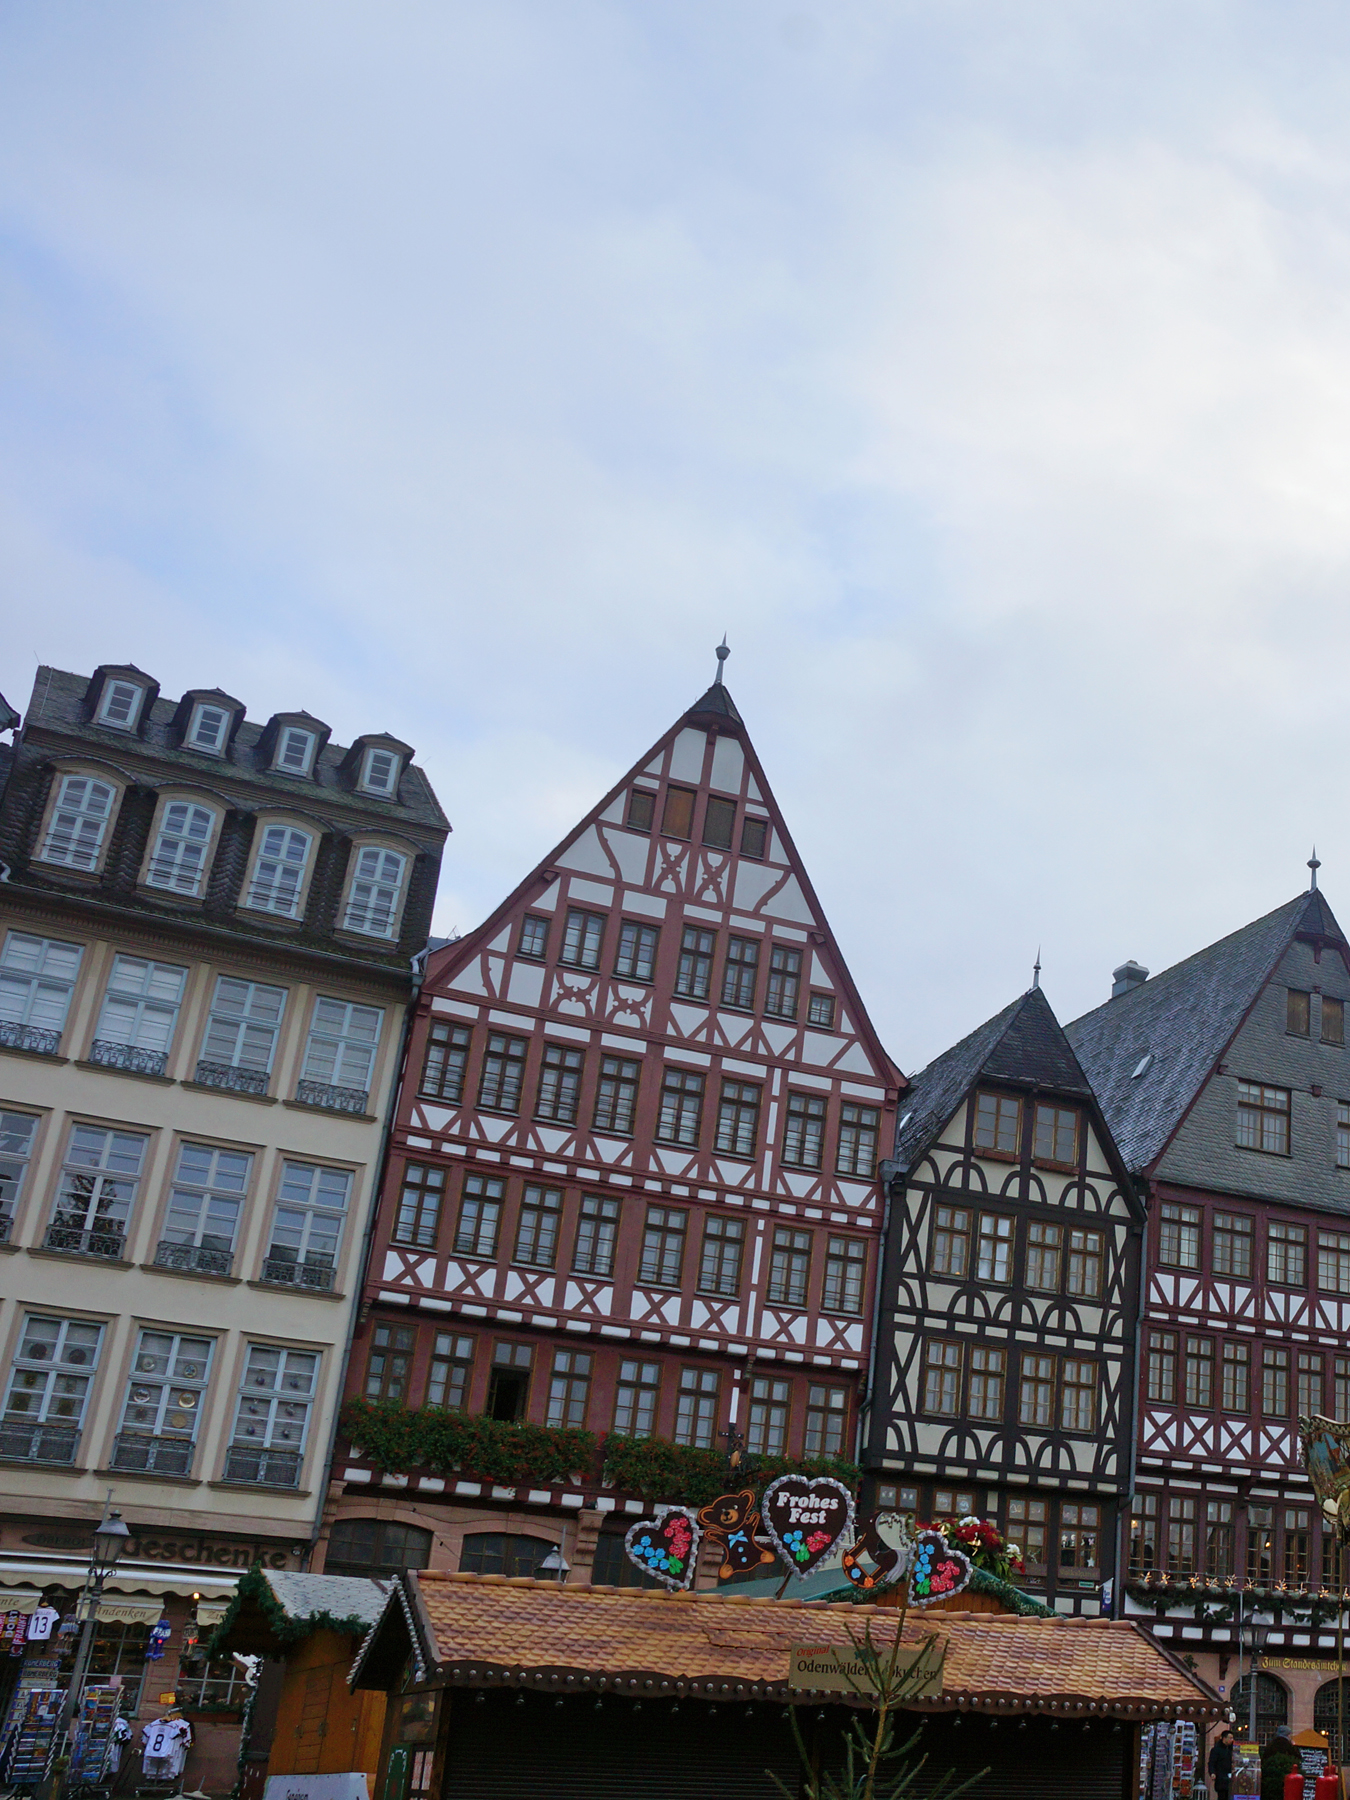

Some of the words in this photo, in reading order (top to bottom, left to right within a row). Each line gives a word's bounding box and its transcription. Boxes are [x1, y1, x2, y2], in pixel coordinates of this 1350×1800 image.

[777, 1492, 839, 1510] Frohes
[789, 1508, 827, 1524] Fest
[120, 1537, 287, 1569] Geschenke
[0, 1597, 20, 1606] nte
[96, 1606, 147, 1619] Andenken
[34, 1616, 48, 1633] 13
[797, 1645, 830, 1657] Original
[797, 1659, 869, 1676] Odenwälder
[1262, 1656, 1281, 1669] Zum
[1282, 1657, 1347, 1671] Standesämtchn
[153, 1734, 164, 1751] 8
